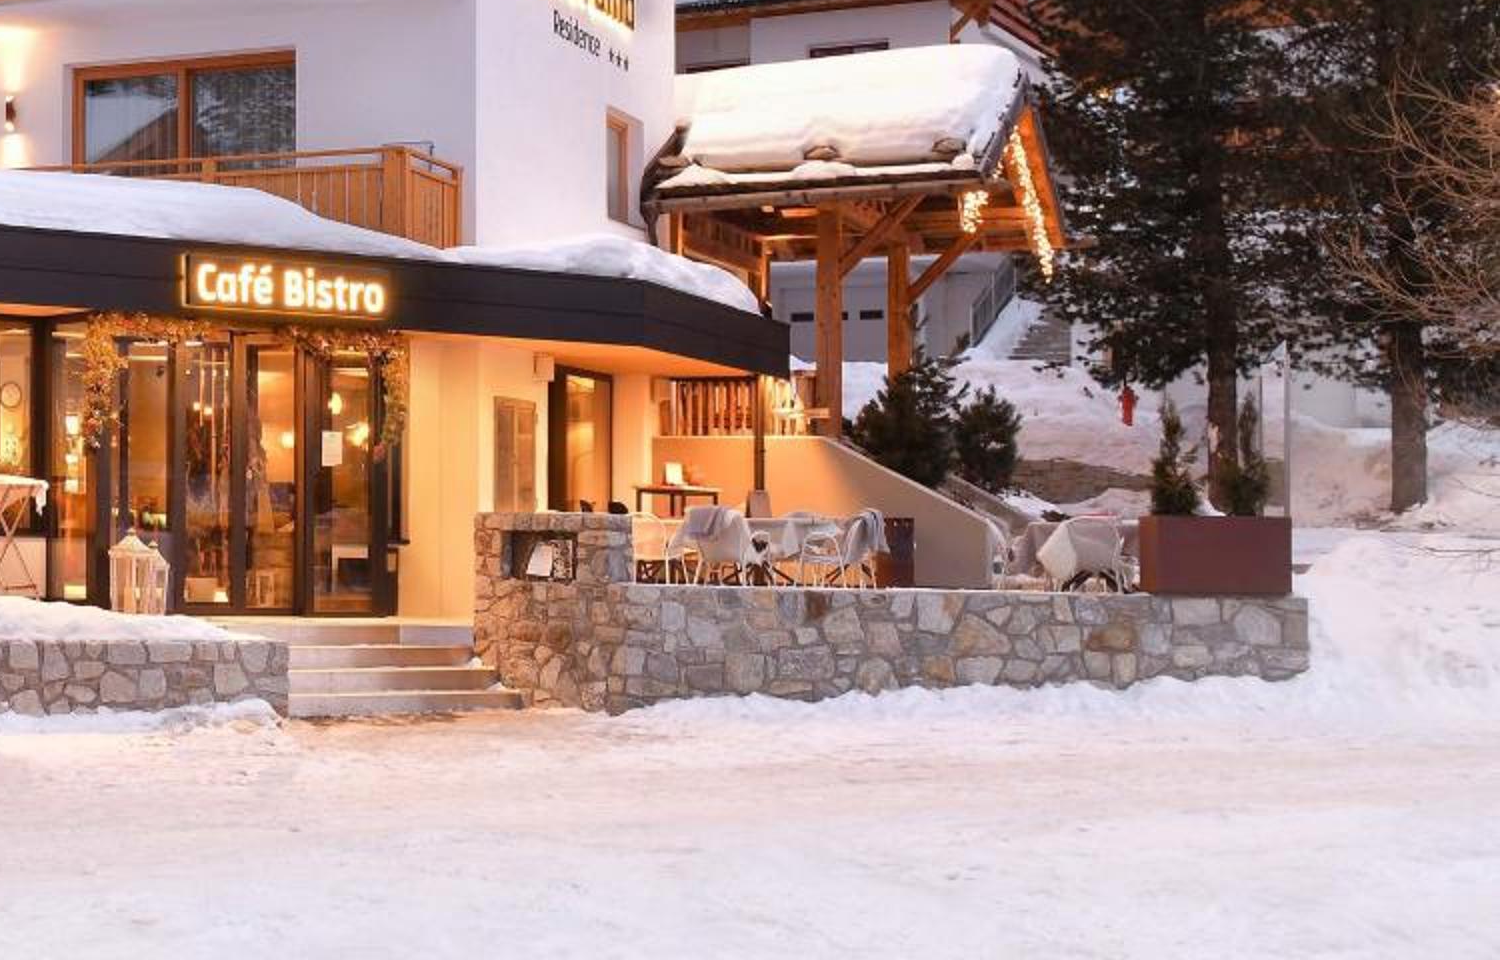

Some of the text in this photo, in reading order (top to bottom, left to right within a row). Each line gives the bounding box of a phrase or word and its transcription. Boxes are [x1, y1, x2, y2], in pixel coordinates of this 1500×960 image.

[553, 9, 601, 57] Residence
[197, 263, 384, 313] Café Bistro
